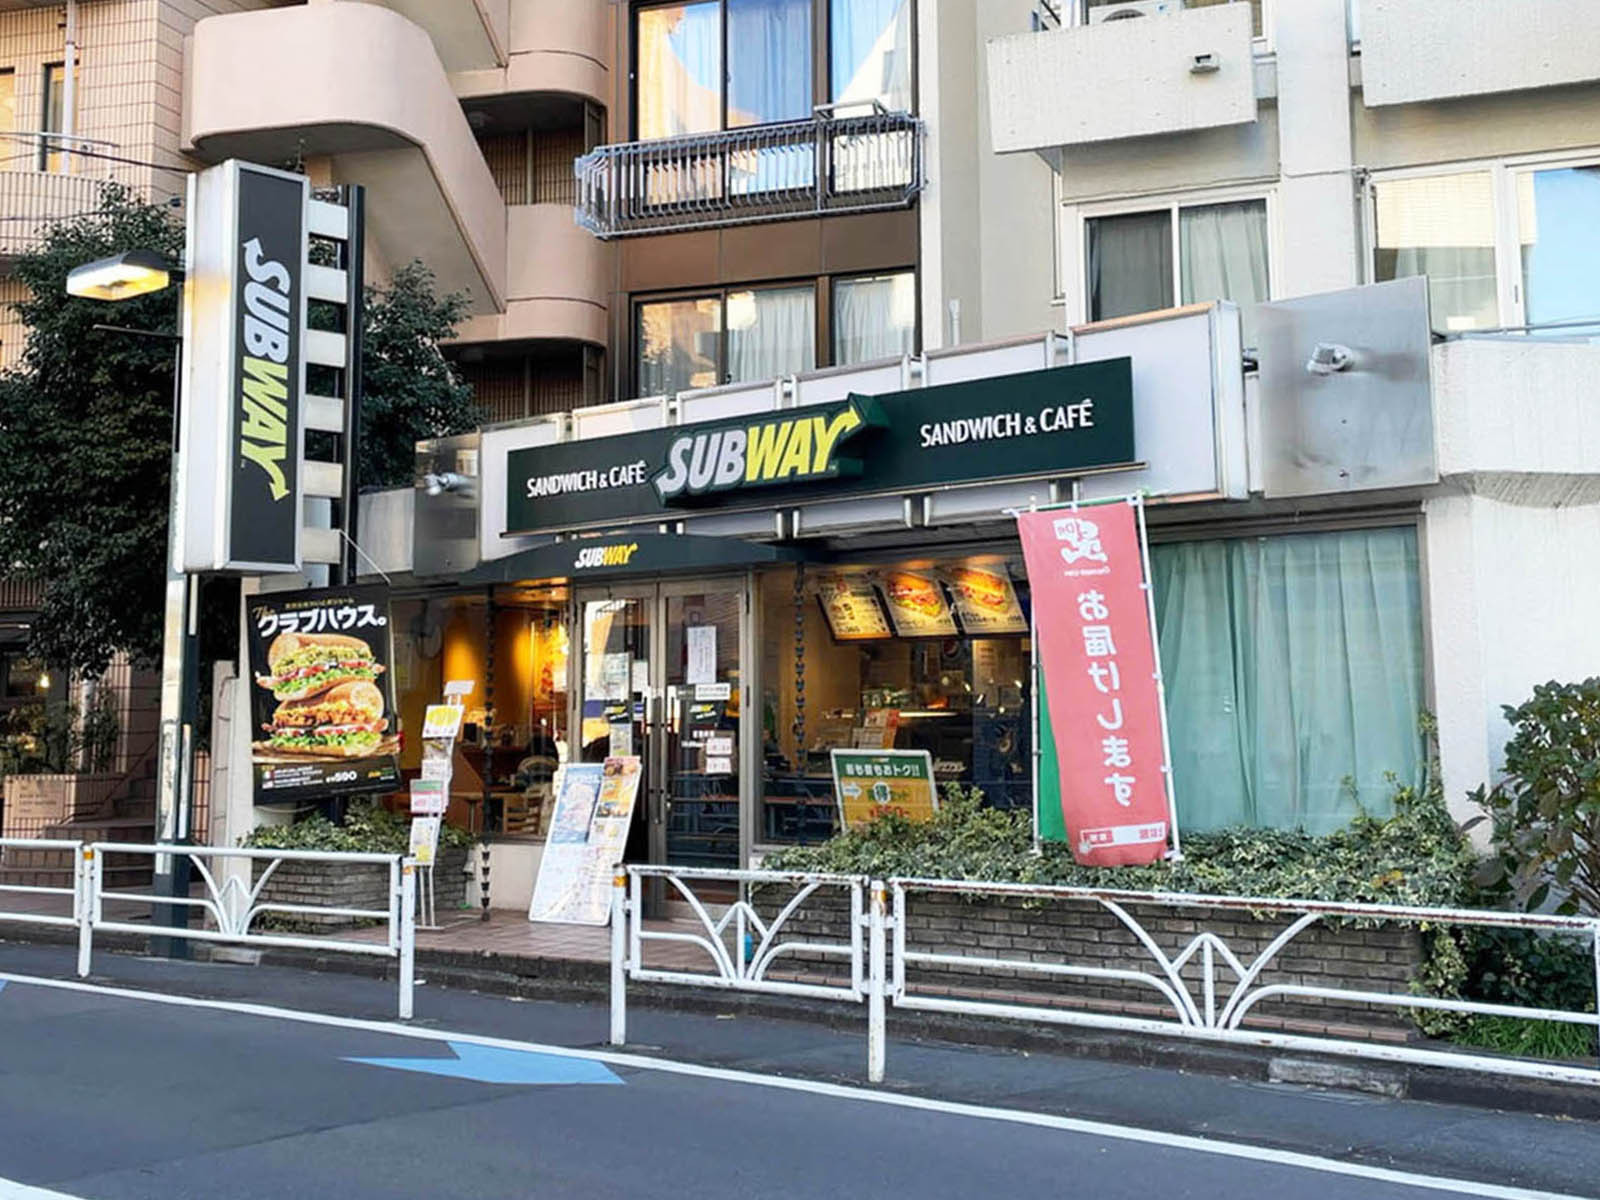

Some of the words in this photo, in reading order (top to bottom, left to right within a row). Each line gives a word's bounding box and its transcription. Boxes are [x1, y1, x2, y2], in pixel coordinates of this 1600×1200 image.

[241, 237, 291, 501] SUBWAY
[920, 412, 1021, 448] SANDWICH
[1024, 416, 1037, 434] &
[1040, 398, 1094, 432] CAFÉ
[655, 405, 861, 496] SUBWAY
[526, 470, 598, 498] SANDWICH
[599, 473, 608, 489] &
[609, 459, 647, 488] CAFÉ
[574, 542, 638, 569] SUBWAY
